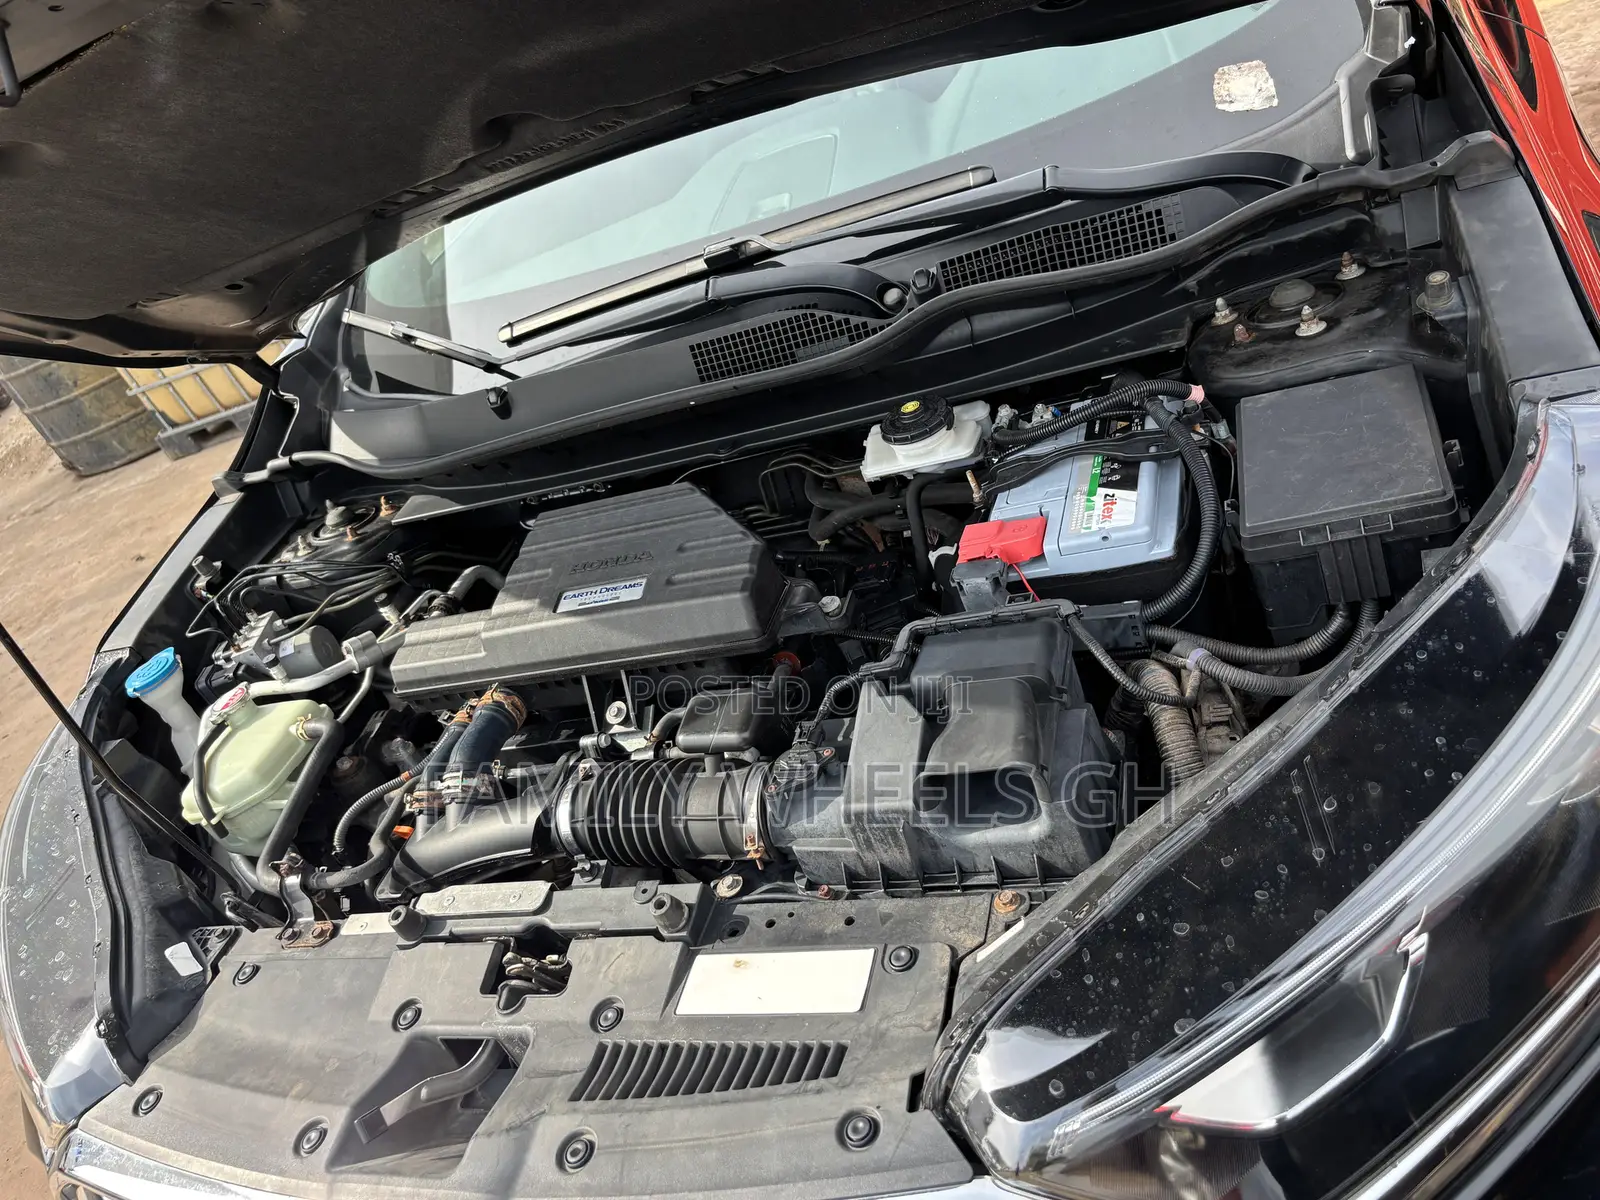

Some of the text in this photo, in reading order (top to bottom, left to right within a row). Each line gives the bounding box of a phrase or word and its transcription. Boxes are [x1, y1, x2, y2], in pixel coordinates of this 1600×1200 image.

[1101, 492, 1118, 520] zitex
[568, 550, 654, 575] HONDA
[563, 589, 598, 601] EARTH
[599, 582, 643, 594] DREAMS
